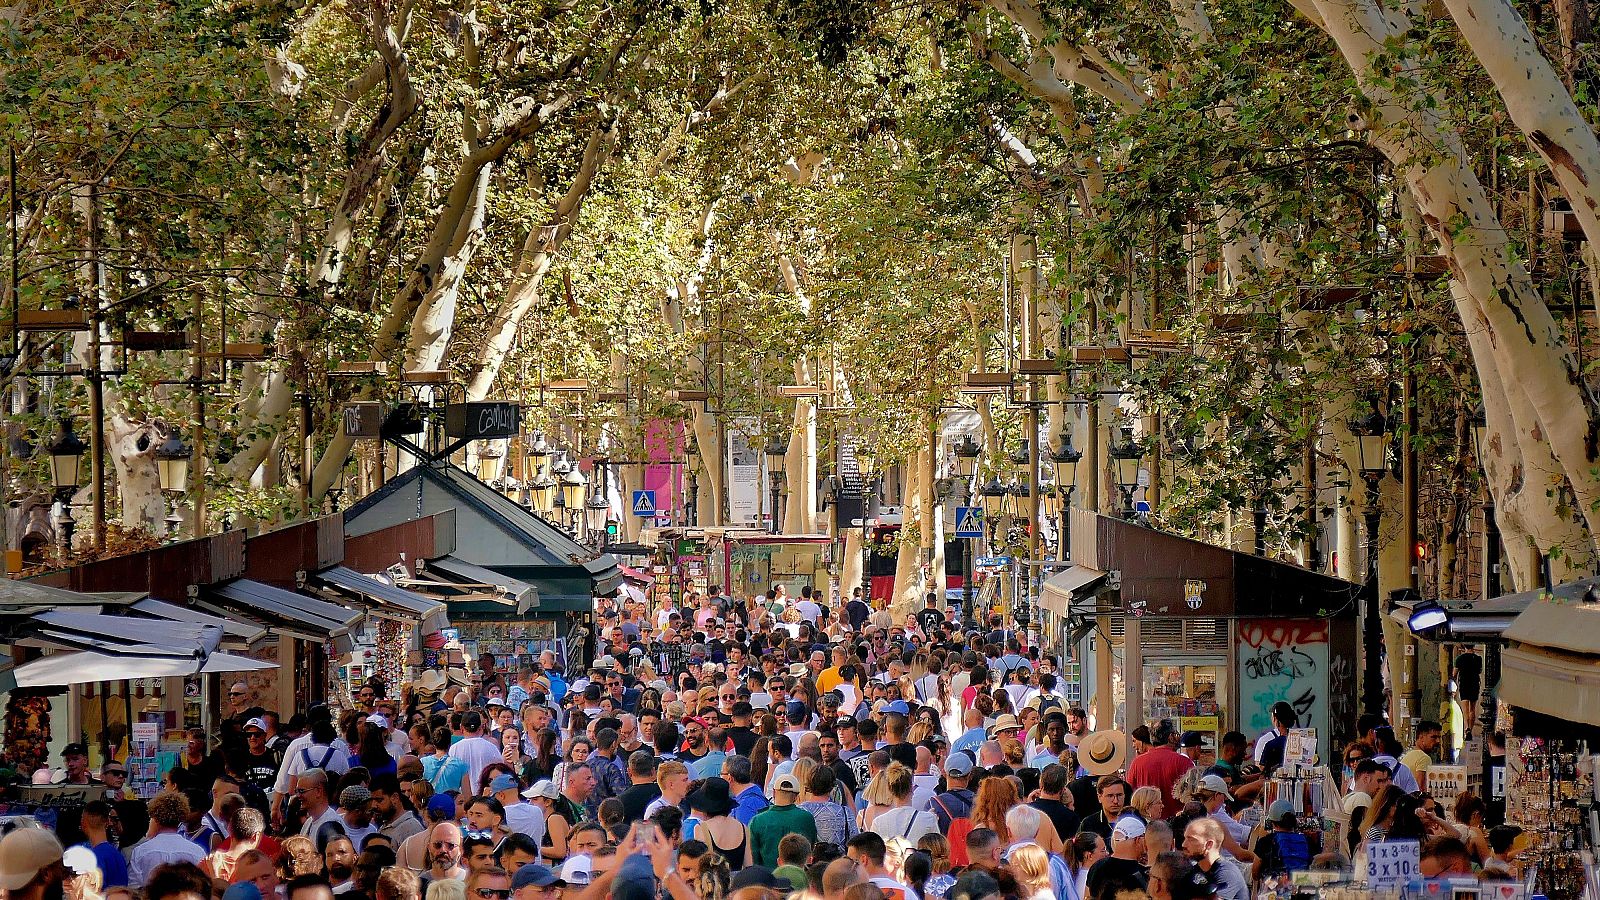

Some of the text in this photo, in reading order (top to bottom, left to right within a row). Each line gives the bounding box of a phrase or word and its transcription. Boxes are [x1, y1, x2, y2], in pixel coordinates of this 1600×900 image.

[1370, 846, 1376, 858] 1
[1381, 848, 1388, 858] x
[1368, 861, 1377, 876] 3
[1382, 864, 1390, 876] x
[1394, 860, 1410, 876] 10
